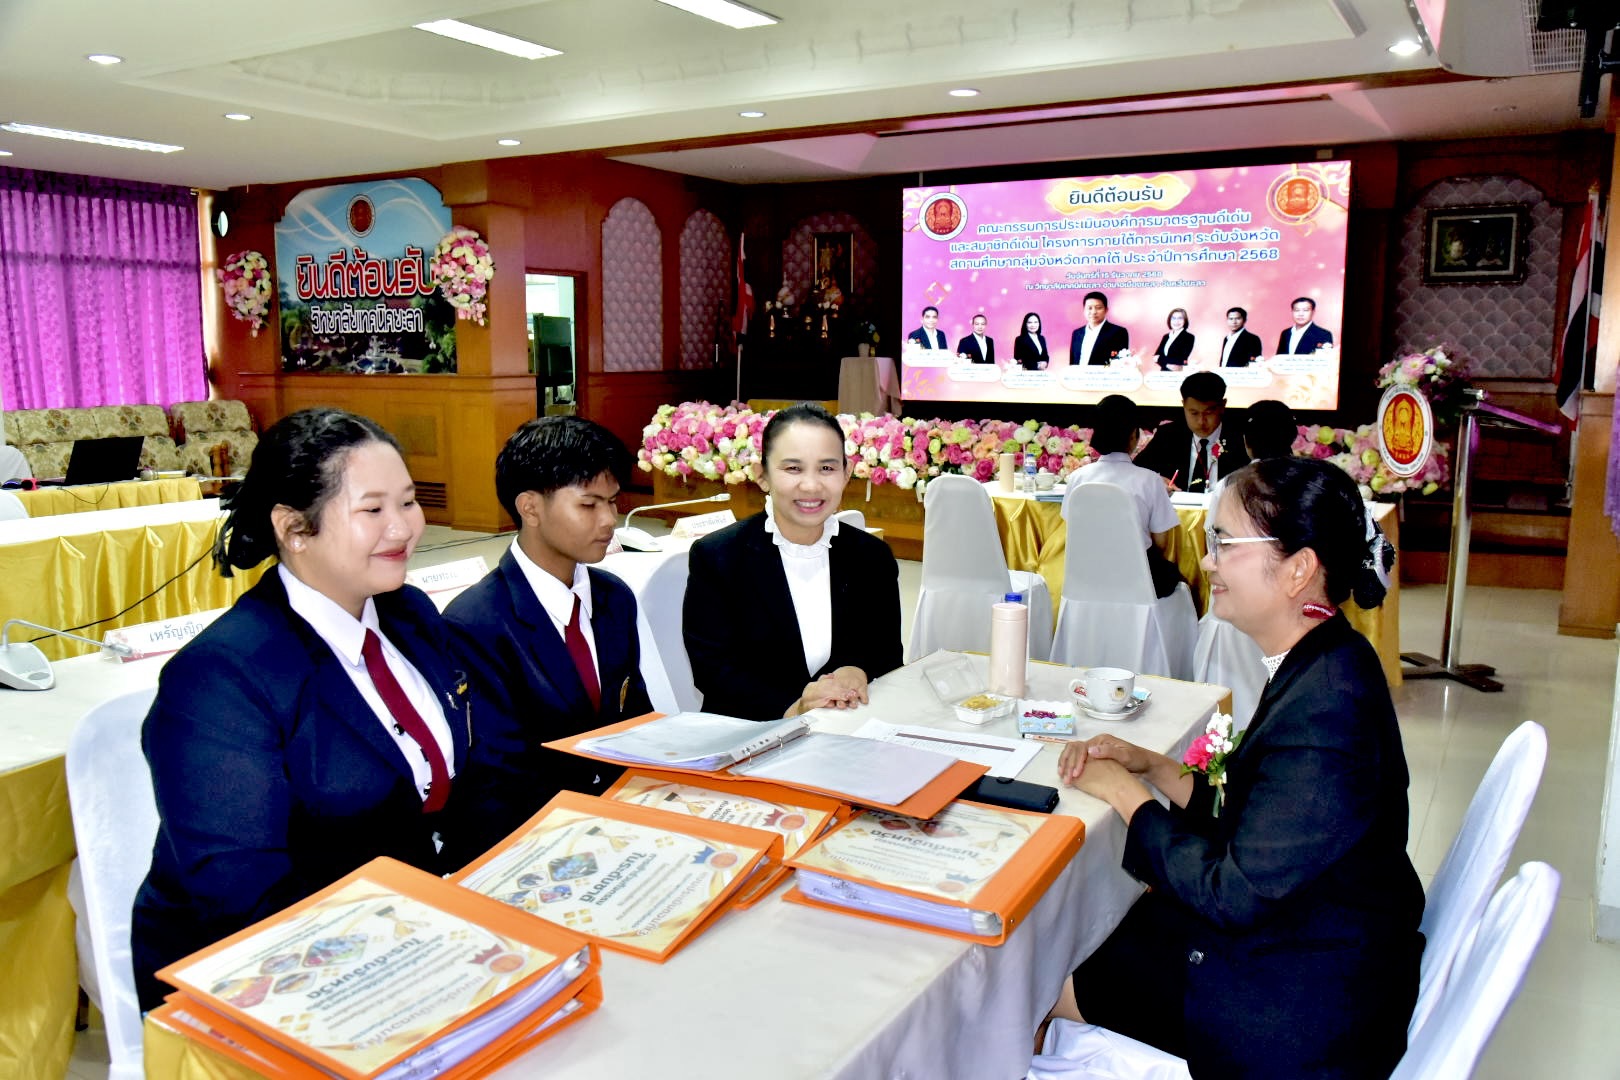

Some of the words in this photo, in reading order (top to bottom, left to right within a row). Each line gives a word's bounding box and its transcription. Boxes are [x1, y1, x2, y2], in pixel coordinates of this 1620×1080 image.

[1069, 185, 1164, 205] ยินดีต้อนรับ
[978, 209, 1250, 233] คณะกรรมการประเมินองค์การมาตรฐานดีเด่น
[951, 237, 1038, 252] และสมาชิกดีเด่น
[1196, 229, 1279, 244] ระดับจังหวัด
[950, 252, 1120, 270] สถานศึกษากลุ่มจังหวัดภาคใต้
[1124, 249, 1236, 264] ประจำปีการศึกษา
[1239, 248, 1279, 261] 2568
[311, 303, 424, 335] วิทยาลัยเทคนิคยะลา
